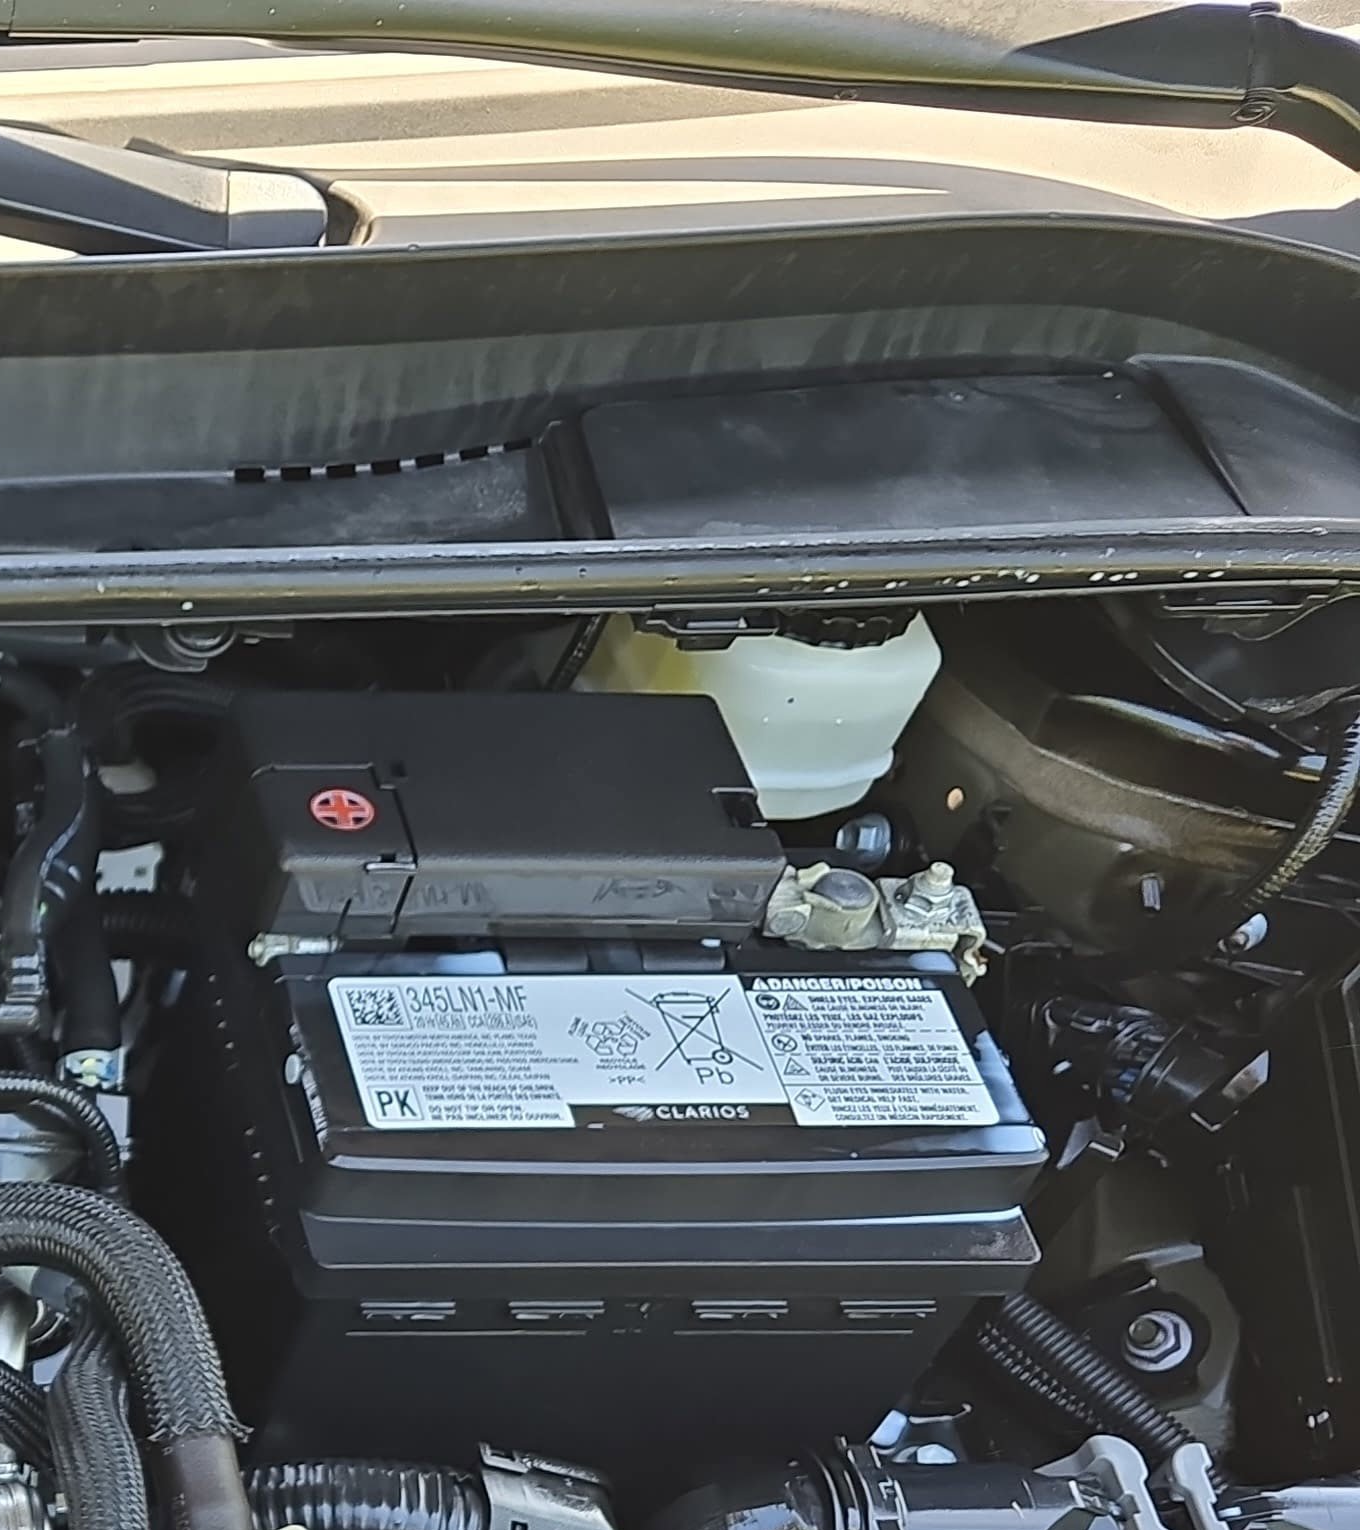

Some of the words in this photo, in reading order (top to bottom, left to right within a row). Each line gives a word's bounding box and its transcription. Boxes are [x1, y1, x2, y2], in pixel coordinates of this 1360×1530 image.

[767, 977, 923, 991] DANGER/POISON
[406, 985, 528, 1013] 345LN1-MF
[696, 1067, 734, 1085] Pb
[375, 1090, 416, 1118] PK
[655, 1105, 749, 1119] CLARIOS
